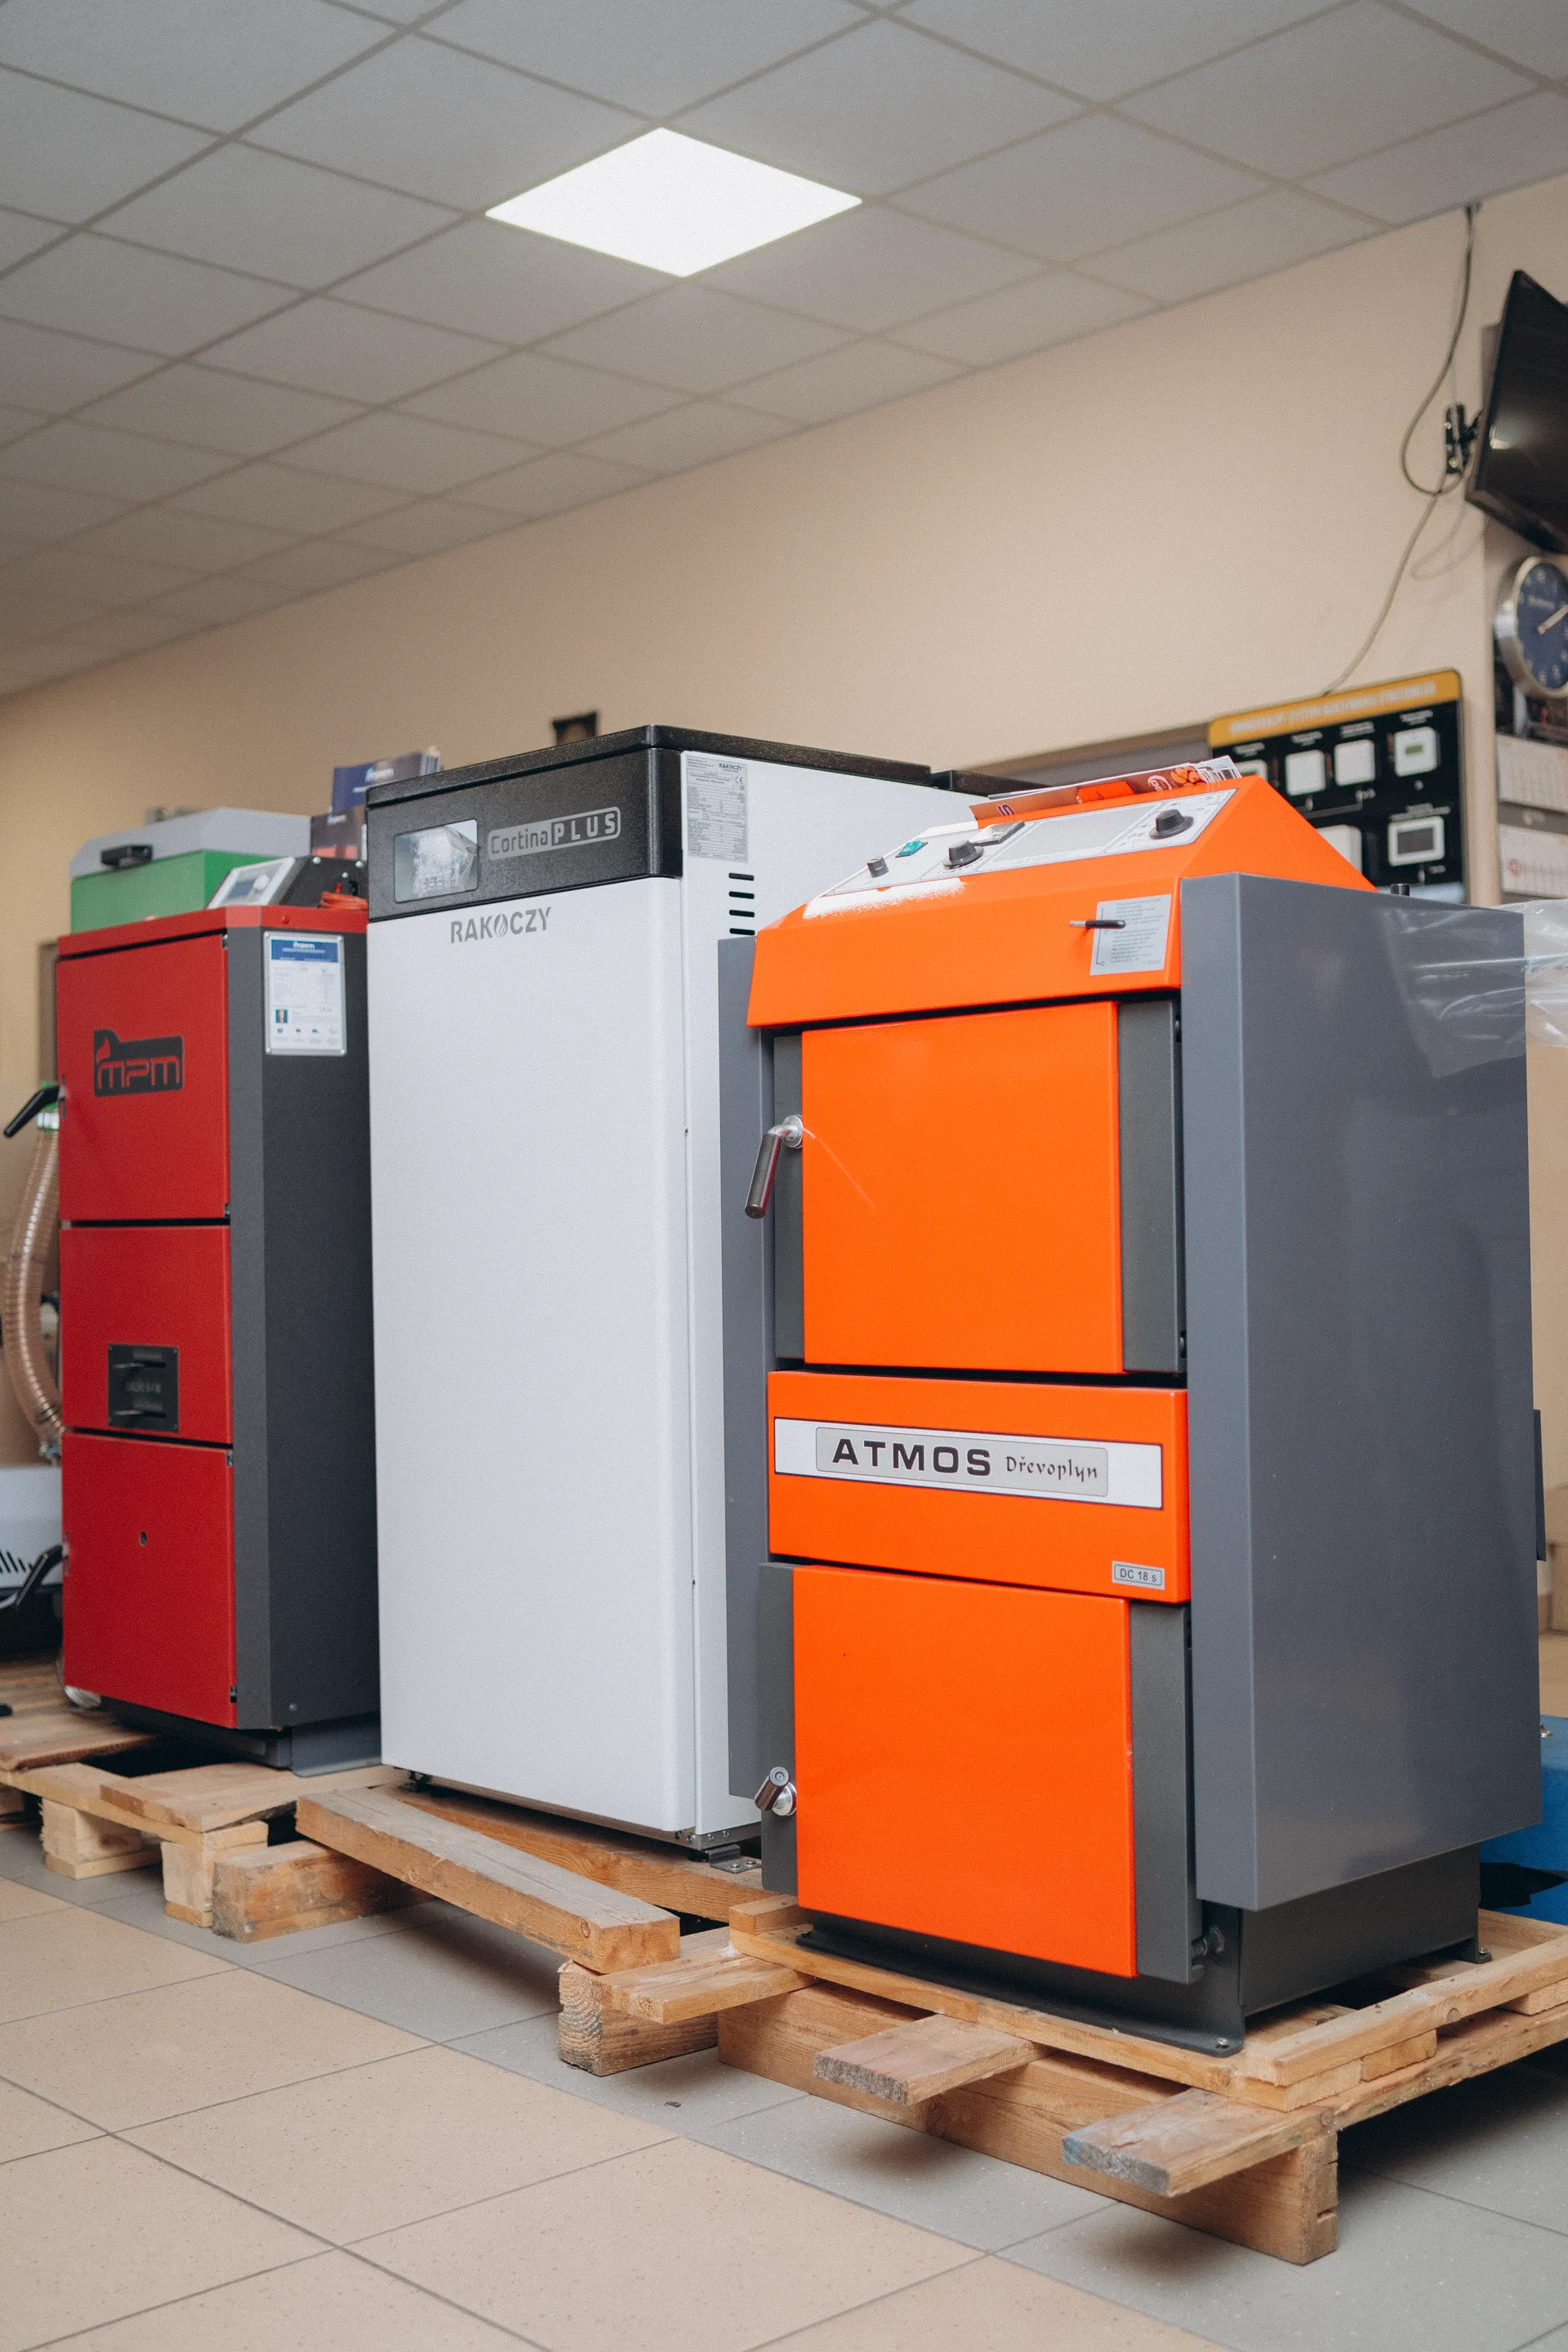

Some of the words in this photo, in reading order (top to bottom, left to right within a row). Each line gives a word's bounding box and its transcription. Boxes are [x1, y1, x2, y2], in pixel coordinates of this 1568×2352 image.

[491, 830, 550, 855] Cortina
[554, 813, 616, 844] PLUS
[450, 906, 552, 943] RAKOCZY
[831, 1438, 991, 1477] ATMOS
[1005, 1455, 1098, 1482] Dřevoplyn
[1120, 1568, 1134, 1579] DC
[1138, 1570, 1148, 1581] 18
